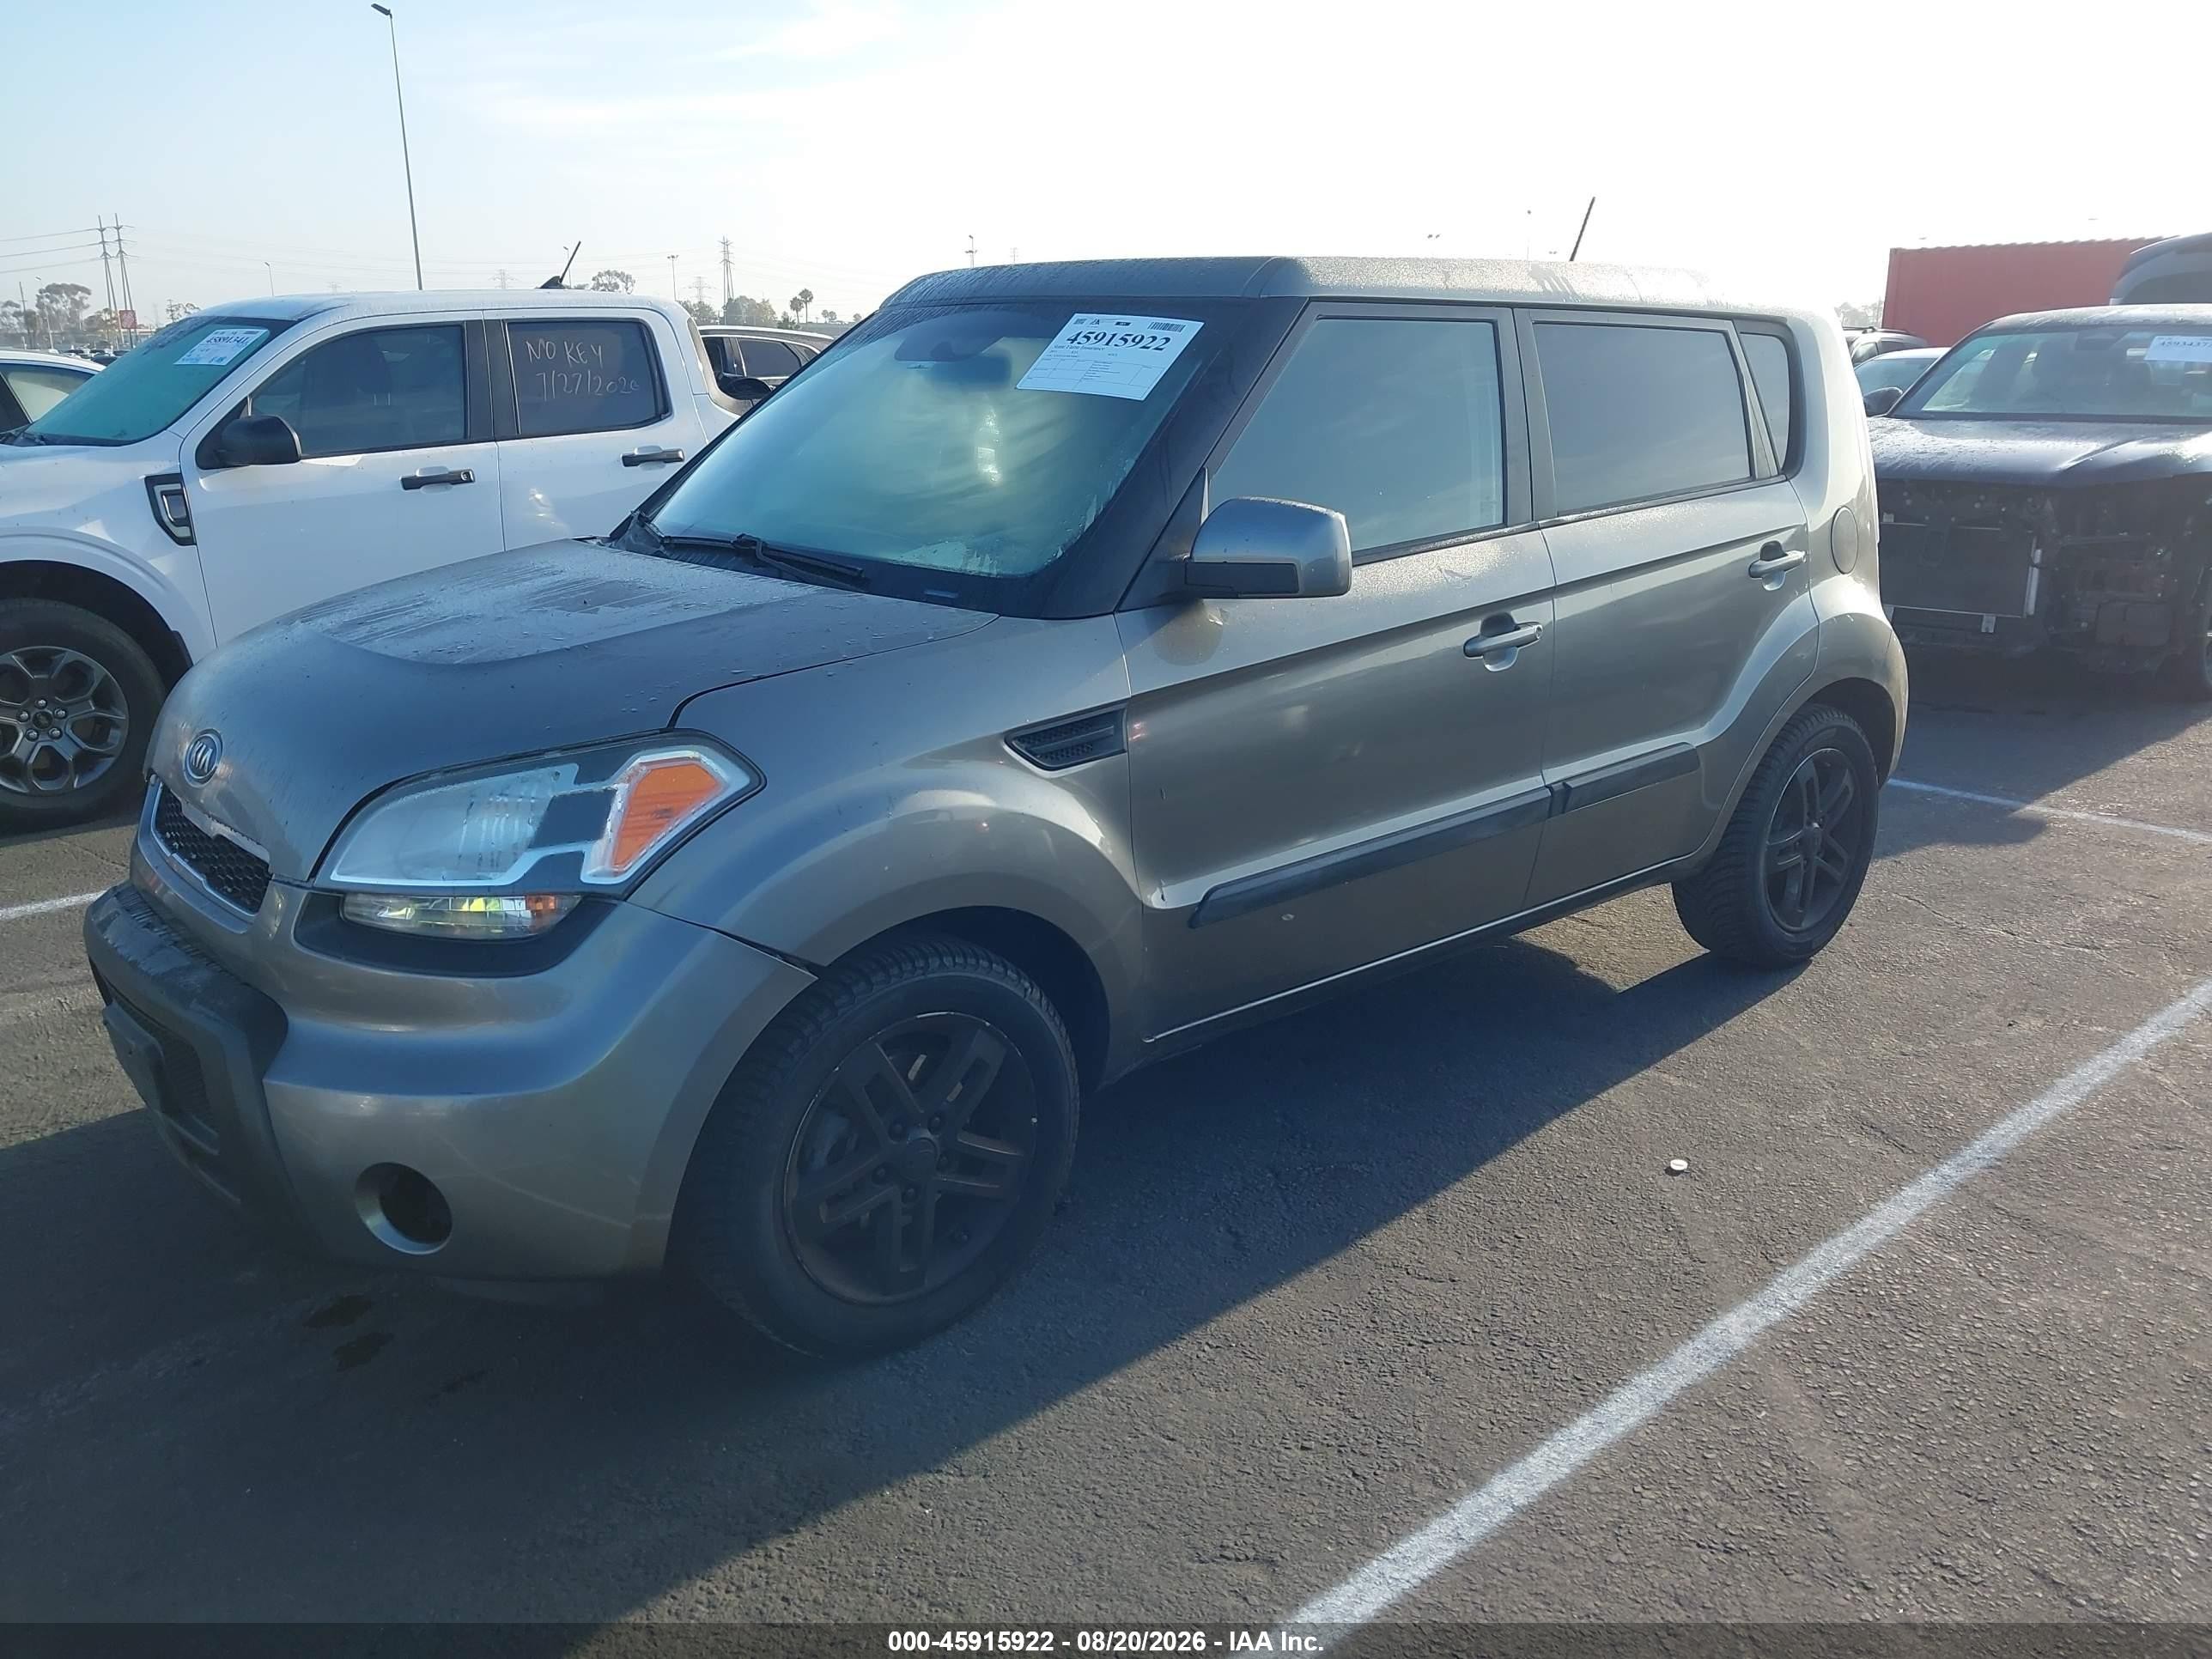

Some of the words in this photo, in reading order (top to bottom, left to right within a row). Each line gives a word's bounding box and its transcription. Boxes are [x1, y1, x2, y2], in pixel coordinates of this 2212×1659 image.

[1066, 330, 1171, 350] 45915922
[526, 339, 556, 362] NO
[563, 341, 603, 367] KEY
